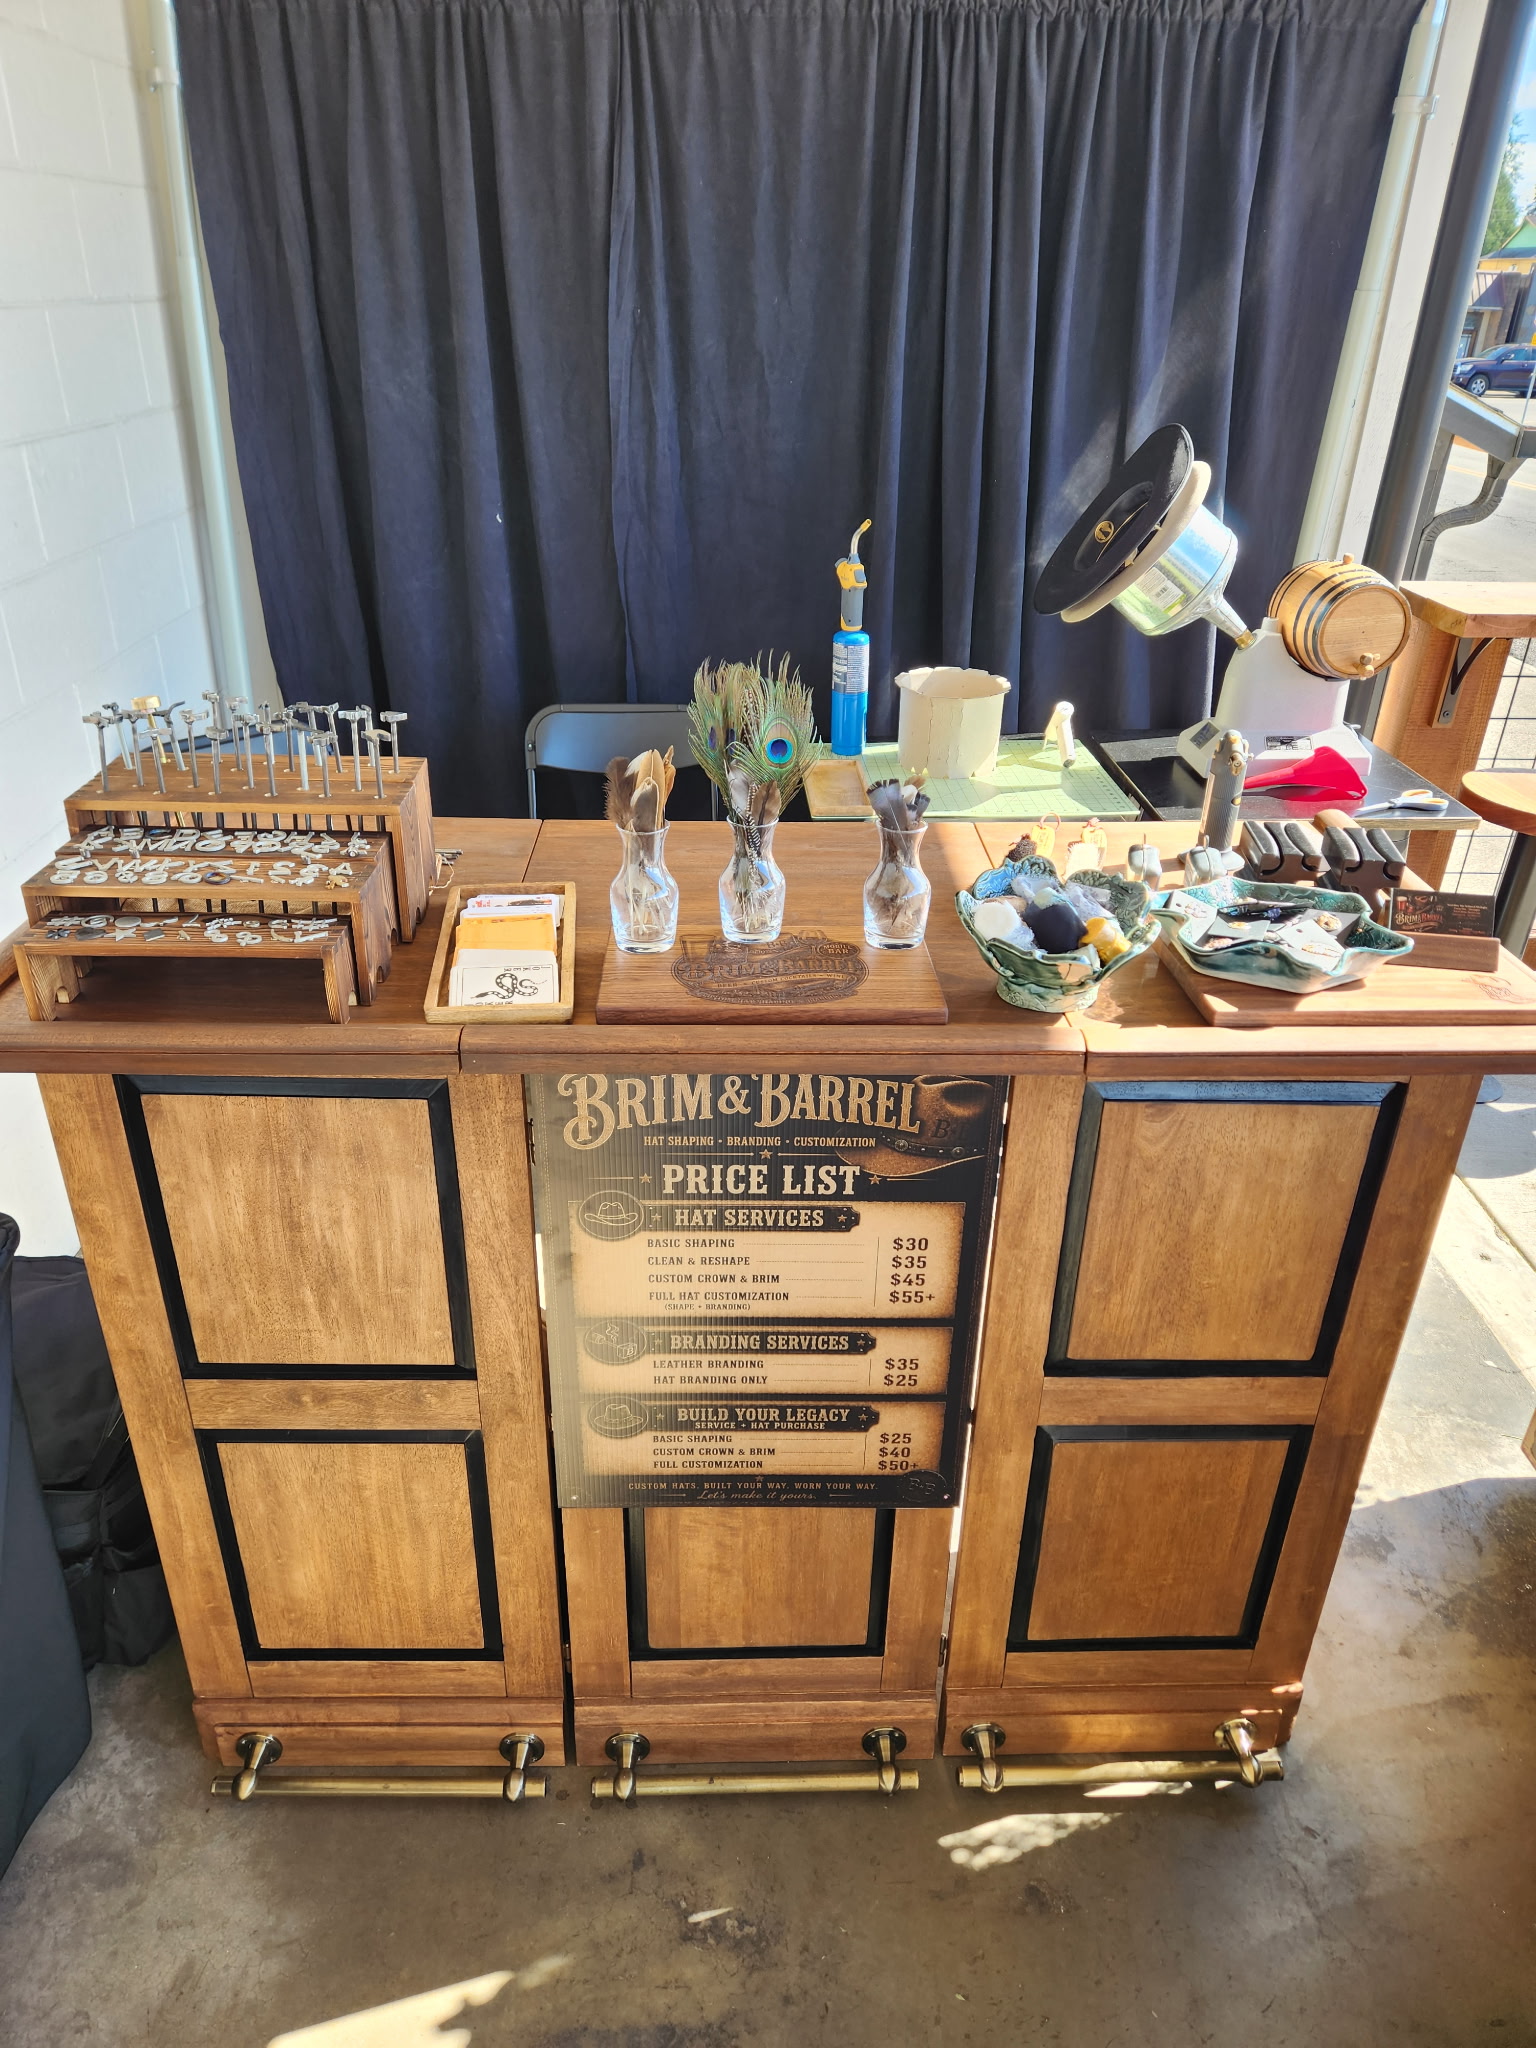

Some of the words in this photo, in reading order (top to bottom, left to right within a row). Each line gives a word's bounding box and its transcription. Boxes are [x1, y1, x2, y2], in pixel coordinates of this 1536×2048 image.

[557, 1074, 713, 1150] BRIM
[717, 1075, 751, 1115] &
[752, 1074, 921, 1134] BARREL
[644, 1136, 665, 1147] HAT
[668, 1136, 714, 1147] SHAPING
[727, 1136, 782, 1147] BRANDING
[793, 1136, 876, 1147] CUSTOMIZATION
[662, 1164, 768, 1195] PRICE
[782, 1164, 861, 1195] LIST
[674, 1209, 717, 1227] HAT
[724, 1209, 825, 1227] SERVICES
[647, 1238, 681, 1248] BASIC
[685, 1238, 735, 1248] SHAPING
[893, 1237, 929, 1252] $30
[648, 1256, 683, 1266] CLEAN
[688, 1256, 696, 1266] &
[700, 1256, 751, 1266] RESHAPE
[891, 1255, 928, 1270] $35
[648, 1274, 693, 1284] CUSTOM
[697, 1274, 736, 1284] CROWN
[740, 1274, 748, 1284] &
[752, 1274, 780, 1284] BRIM
[890, 1272, 926, 1287] $45
[649, 1291, 676, 1301] FULL
[679, 1291, 701, 1301] HAT
[704, 1291, 790, 1301] CUSTOMIZATION
[889, 1290, 936, 1305] $55+
[670, 1335, 761, 1350] BRANDING
[766, 1335, 850, 1350] SERVICES
[653, 1360, 703, 1369] LEATHER
[707, 1360, 764, 1369] BRANDING
[884, 1357, 920, 1371] $35
[653, 1375, 676, 1385] HAT
[679, 1375, 737, 1385] BRANDING
[741, 1375, 769, 1385] ONLY
[883, 1373, 918, 1387] $25
[677, 1408, 729, 1422] BUILD
[735, 1408, 780, 1422] YOUR
[786, 1408, 851, 1422] LEGACY
[695, 1422, 736, 1430] SERVICE
[751, 1422, 770, 1430] HAT
[774, 1422, 826, 1430] PURCHASE
[653, 1435, 684, 1443] BASIC
[687, 1435, 733, 1443] SHAPING
[879, 1432, 912, 1445] $25
[653, 1448, 695, 1456] CUSTOM
[698, 1448, 735, 1456] CROWN
[738, 1448, 746, 1456] &
[749, 1448, 776, 1456] BRIM
[878, 1446, 911, 1458] $40
[653, 1460, 679, 1469] FULL
[681, 1460, 763, 1469] CUSTOMIZATION
[878, 1460, 919, 1471] $50+
[628, 1482, 667, 1490] CUSTOM
[672, 1482, 700, 1490] HATS.
[704, 1482, 732, 1490] BUILT
[737, 1482, 763, 1490] YOUR
[794, 1482, 822, 1490] WORN
[826, 1482, 851, 1490] YOUR
[697, 1489, 726, 1500] Let's
[730, 1490, 763, 1500] make
[766, 1490, 777, 1500] it
